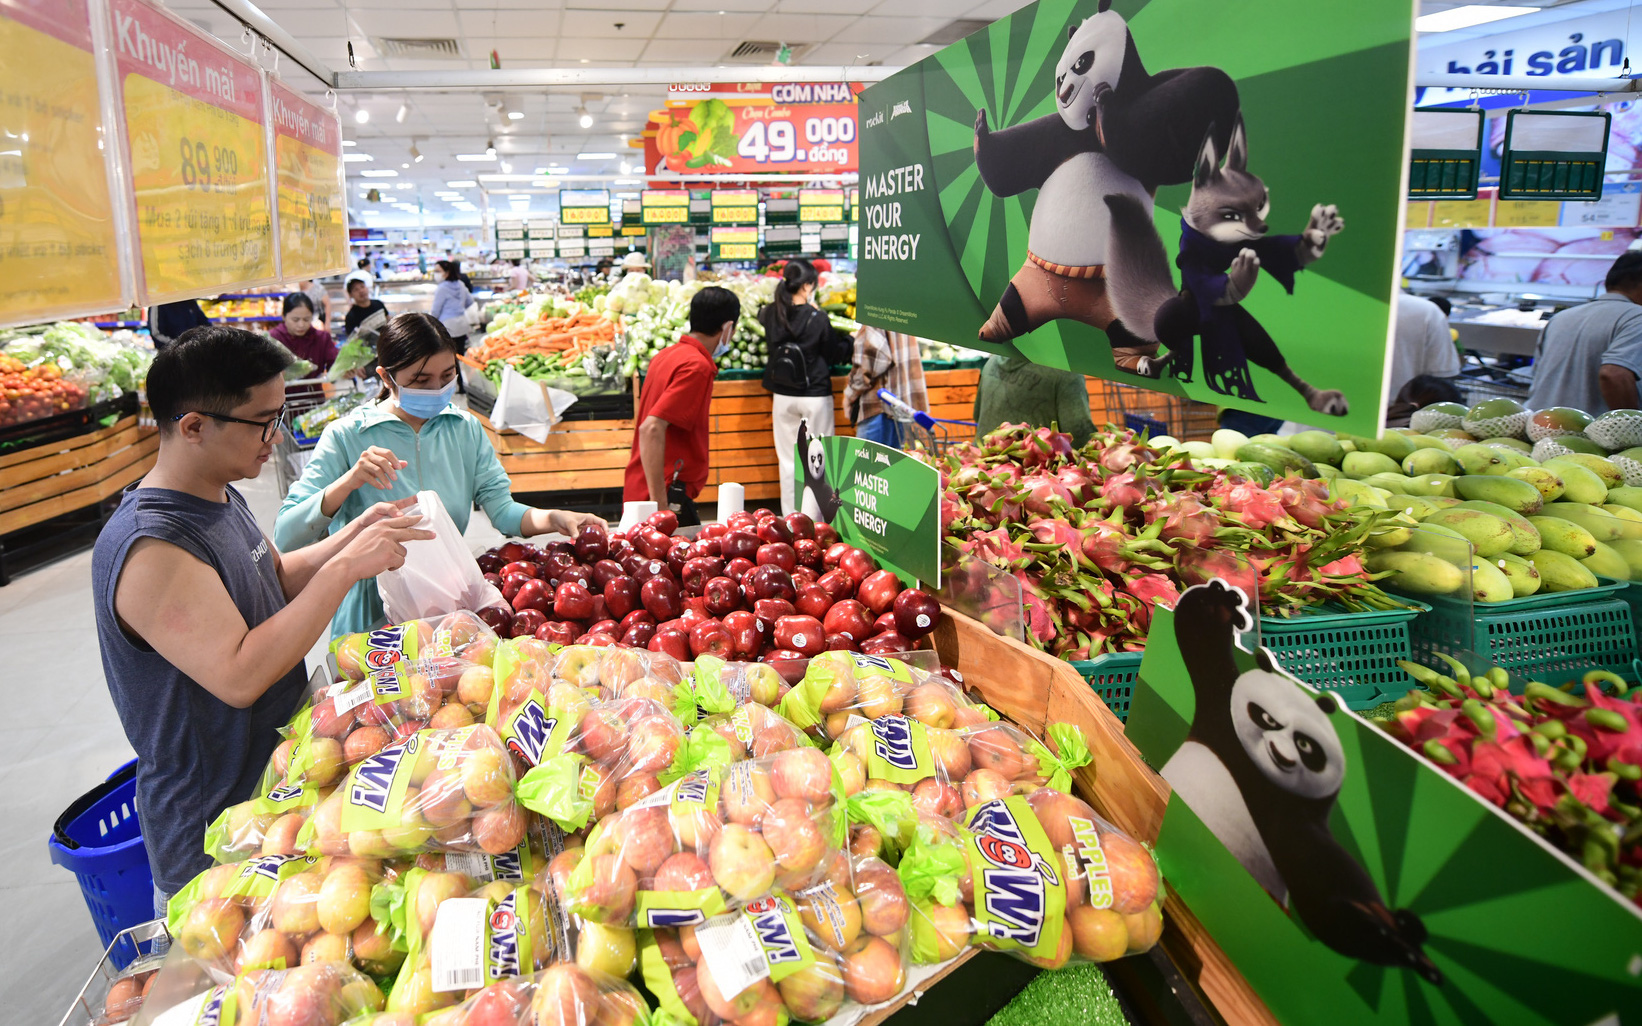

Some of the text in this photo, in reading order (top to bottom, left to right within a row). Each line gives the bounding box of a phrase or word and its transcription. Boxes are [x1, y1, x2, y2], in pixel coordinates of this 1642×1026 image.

[115, 9, 236, 103] Khuyến mãi
[1526, 32, 1624, 77] sản
[772, 84, 812, 103] CƠM
[272, 95, 310, 138] Khuyến
[180, 136, 238, 193] 89 900
[809, 142, 848, 165] đồng
[865, 163, 924, 199] MASTER
[865, 202, 902, 230] YOUR
[864, 233, 921, 260] ENERGY
[854, 470, 889, 497] MASTER
[854, 488, 877, 512] YOUR
[854, 507, 888, 537] ENERGY
[967, 798, 1043, 949] WOW!
[1067, 816, 1115, 910] APPLES
